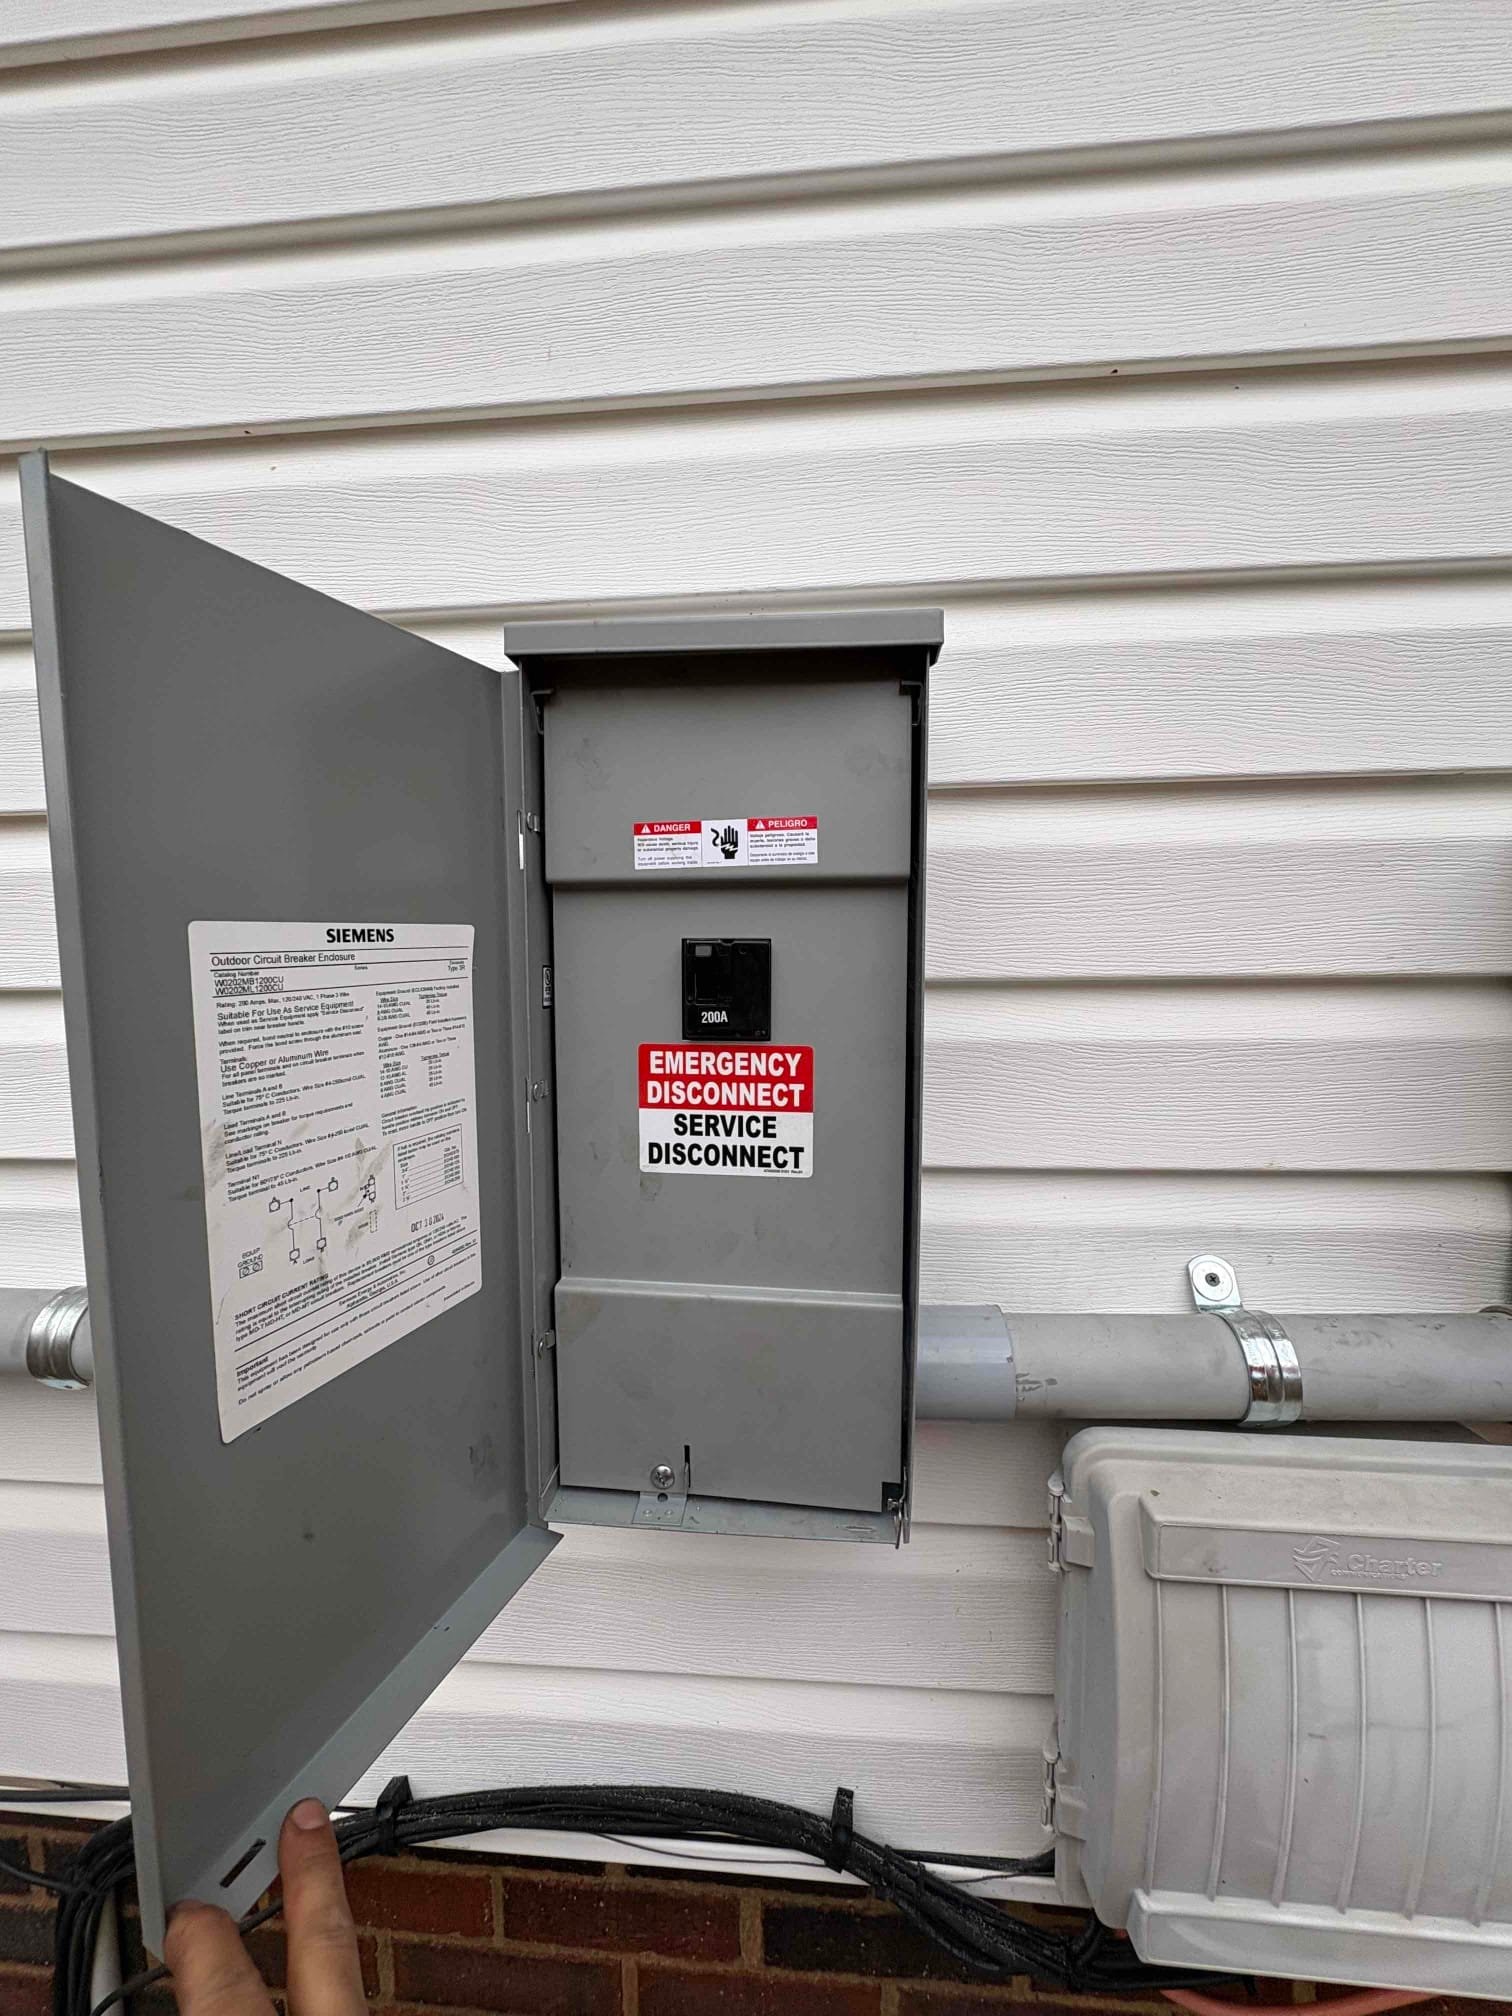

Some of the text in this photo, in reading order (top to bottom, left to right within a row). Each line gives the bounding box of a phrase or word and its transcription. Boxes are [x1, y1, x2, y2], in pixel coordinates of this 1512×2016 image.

[653, 823, 691, 833] DANGER
[768, 819, 808, 828] PELIGRO
[326, 928, 395, 944] SIEMENS
[212, 953, 355, 966] Outdoor Circuit Breaker Enclosure
[214, 976, 284, 987] W0202MB1200CU
[215, 984, 283, 995] W0202ML1200CU
[217, 1011, 249, 1020] Suitable
[252, 1009, 264, 1017] For
[320, 1001, 354, 1012] Equipment
[701, 1010, 728, 1024] 200A
[220, 1065, 236, 1074] Use
[239, 1060, 267, 1070] Copper
[278, 1053, 312, 1064] Aluminum
[649, 1050, 802, 1077] EMERGENCY
[647, 1080, 805, 1108] DISCONNECT
[673, 1113, 777, 1139] SERVICE
[648, 1142, 805, 1169] DISCONNECT
[411, 1220, 422, 1232] OCT
[238, 1254, 263, 1268] GROUND
[235, 1274, 328, 1320] SHORT CIRCUIT CURRENT RATING
[237, 1356, 268, 1377] Important
[1347, 1553, 1443, 1577] Charter
